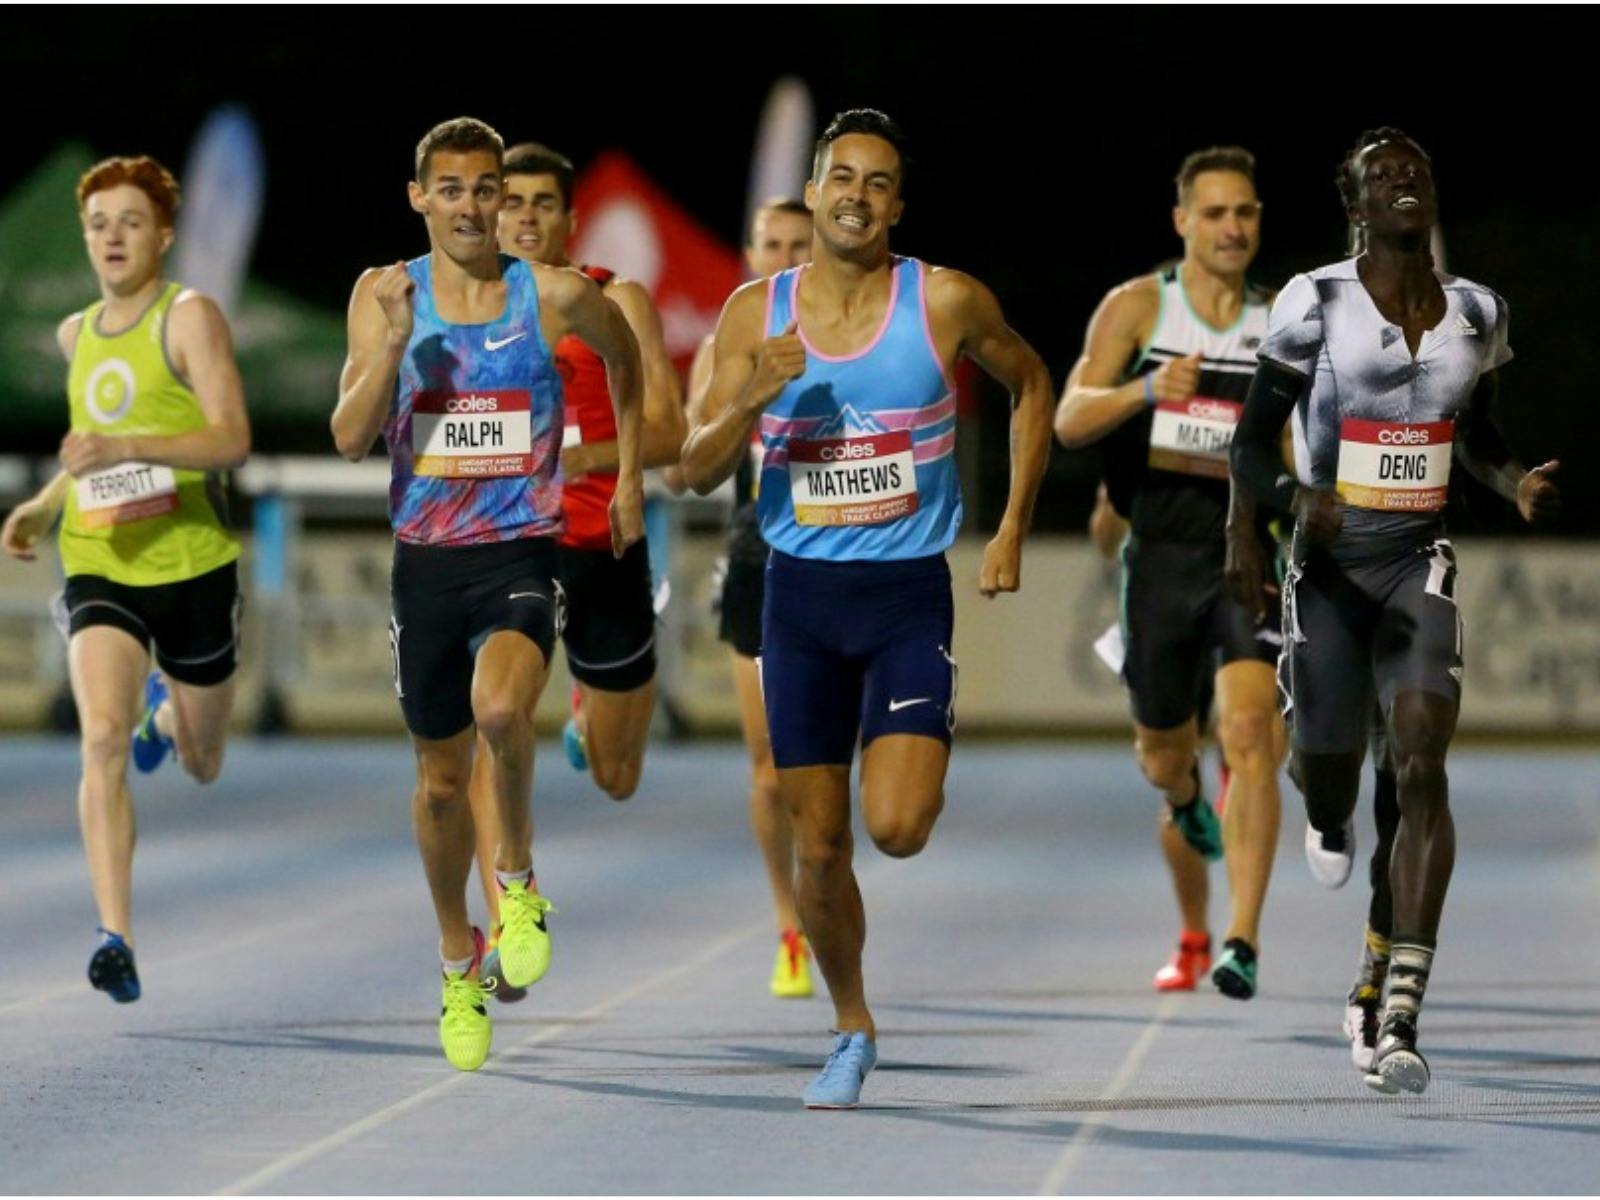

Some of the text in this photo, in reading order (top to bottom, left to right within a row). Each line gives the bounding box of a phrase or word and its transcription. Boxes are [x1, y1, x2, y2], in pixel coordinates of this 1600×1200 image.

[446, 394, 498, 412] coles
[445, 421, 503, 448] RALPH
[1378, 426, 1430, 444] coles
[820, 441, 875, 460] coles
[807, 462, 902, 497] MATHEWS
[1379, 453, 1427, 480] DENG
[90, 467, 155, 500] PERROTT
